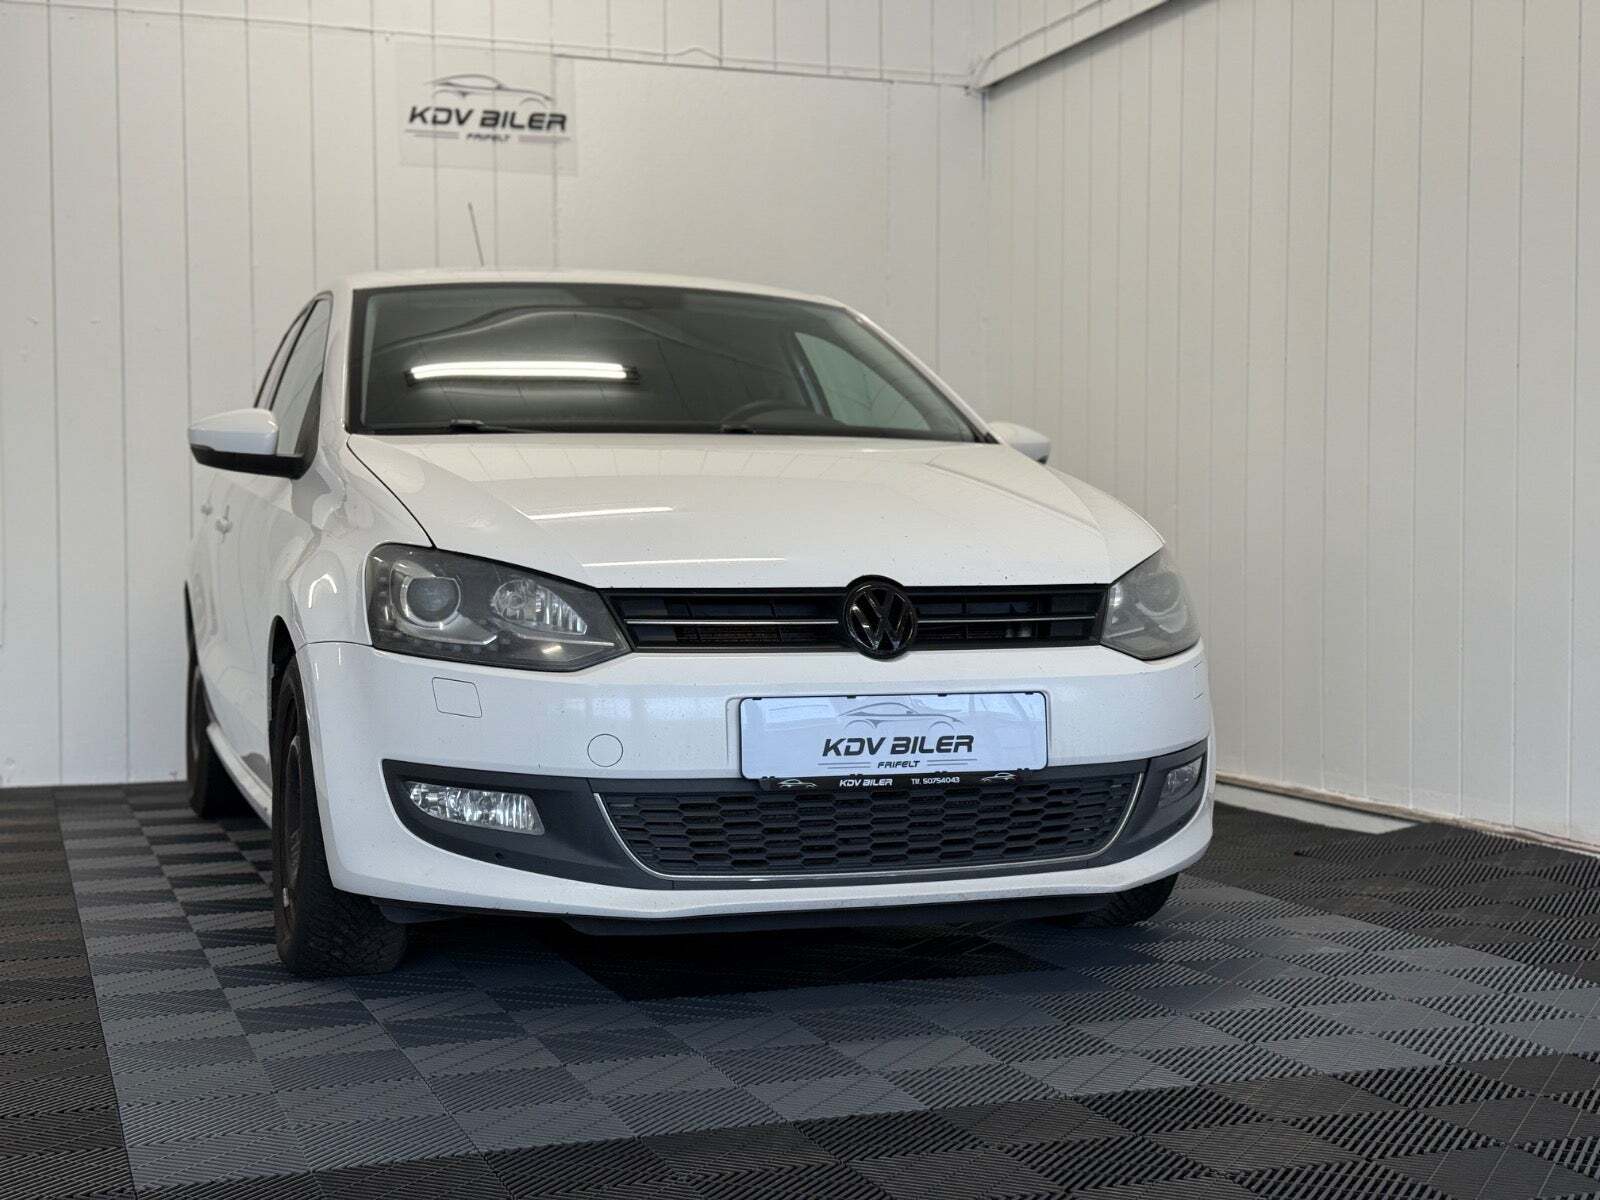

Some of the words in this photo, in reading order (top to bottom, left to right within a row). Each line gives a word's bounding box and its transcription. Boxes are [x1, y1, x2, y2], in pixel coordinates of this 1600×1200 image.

[408, 105, 475, 126] KDV
[479, 109, 568, 132] BILER
[822, 736, 887, 757] KDV
[890, 734, 974, 755] BILER
[877, 759, 921, 769] FRIFELT
[839, 778, 862, 787] KDV
[862, 778, 893, 787] BILER
